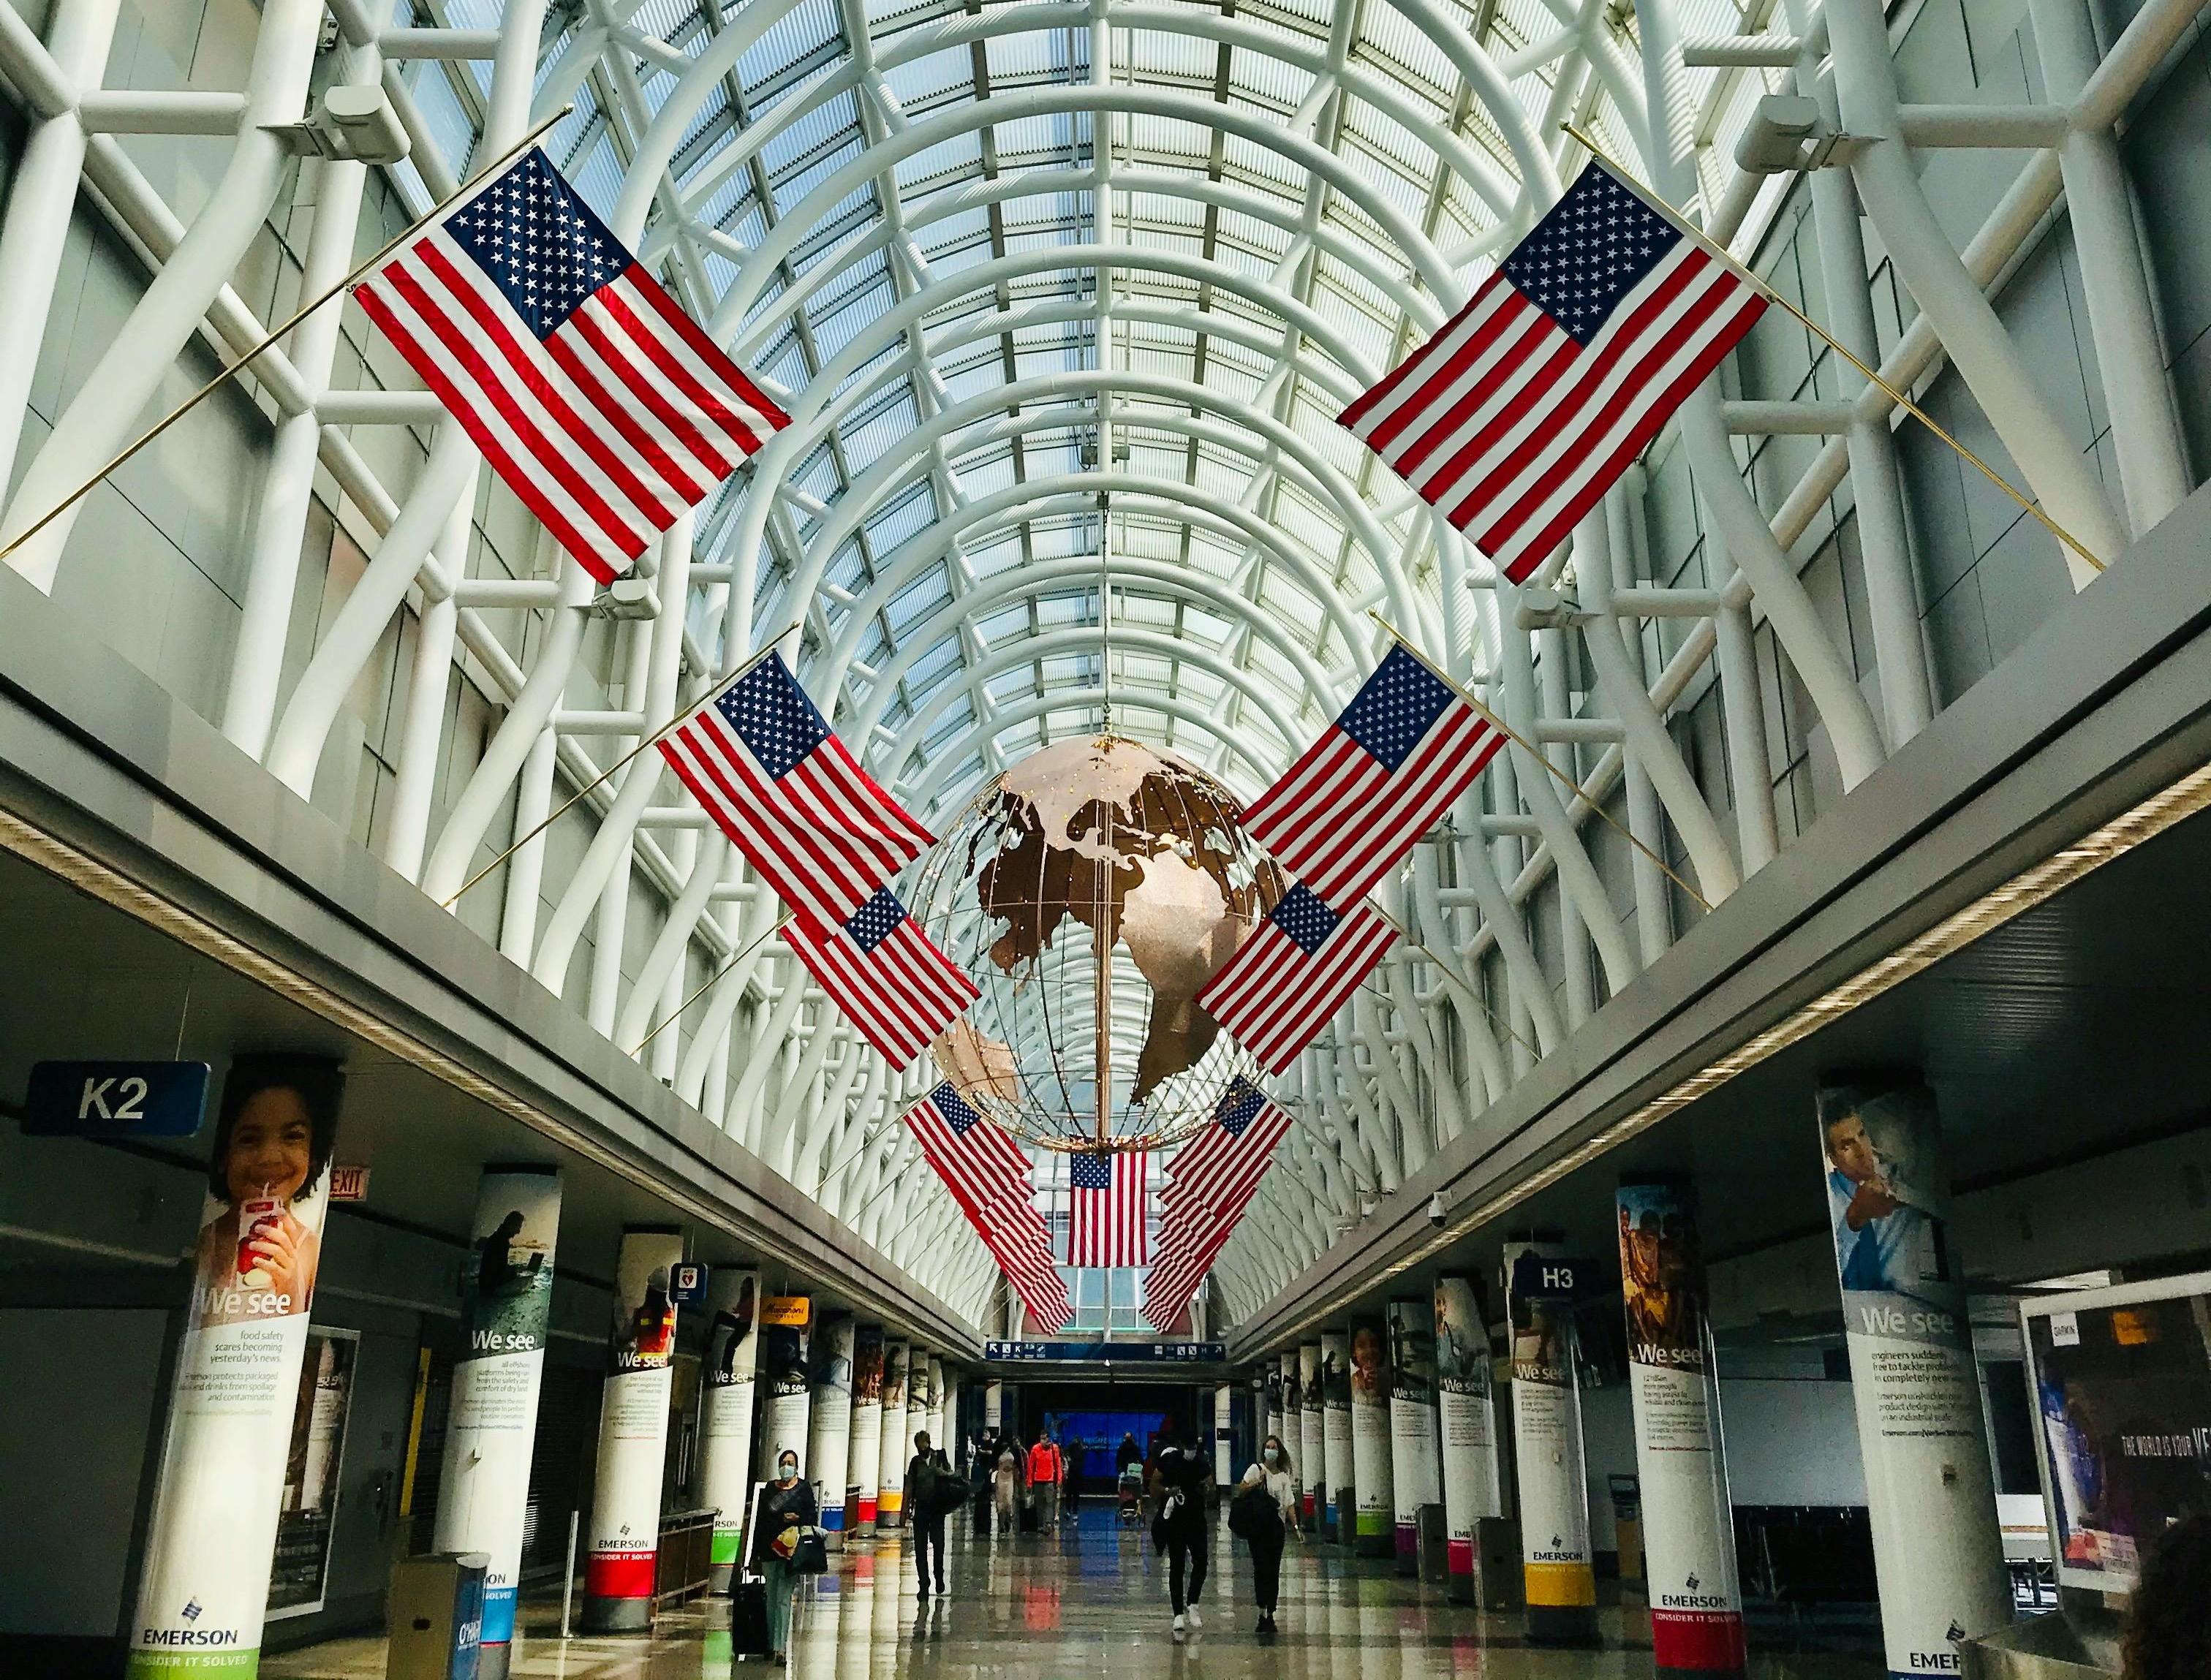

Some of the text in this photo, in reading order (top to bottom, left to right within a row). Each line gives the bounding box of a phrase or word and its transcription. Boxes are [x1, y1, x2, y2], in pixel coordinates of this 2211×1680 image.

[78, 1077, 148, 1119] K2
[330, 1170, 363, 1192] EXIT
[1543, 1267, 1573, 1288] H3
[200, 1287, 290, 1314] We see
[1860, 1306, 1954, 1333] We see
[241, 1331, 284, 1342] food safety
[472, 1331, 534, 1350] We see
[216, 1342, 282, 1353] scares becoming
[1637, 1343, 1702, 1363] We see
[211, 1354, 257, 1363] yesterday's
[618, 1352, 665, 1367] We see
[1517, 1364, 1565, 1380] We see
[1873, 1362, 1887, 1371] free
[1888, 1363, 1897, 1371] to
[1898, 1361, 1926, 1371] tackle
[246, 1371, 278, 1382] packaged
[710, 1370, 748, 1383] We see
[1883, 1374, 1930, 1383] completely
[773, 1382, 806, 1393] We see
[1444, 1379, 1462, 1392] We
[1393, 1388, 1407, 1399] We
[2122, 1436, 2136, 1456] THE
[2136, 1436, 2162, 1456] WORLD
[2163, 1436, 2172, 1456] IS
[2172, 1435, 2193, 1456] YOUR
[598, 1540, 649, 1548] EMERSON
[1533, 1551, 1583, 1561] EMERSON
[1662, 1594, 1727, 1608] EMERSON
[1655, 1613, 1694, 1622] CONSIDER
[143, 1630, 238, 1645] EMERSON
[132, 1654, 249, 1668] ONSIDER IT SOLVED
[1910, 1652, 1960, 1669] EMER
